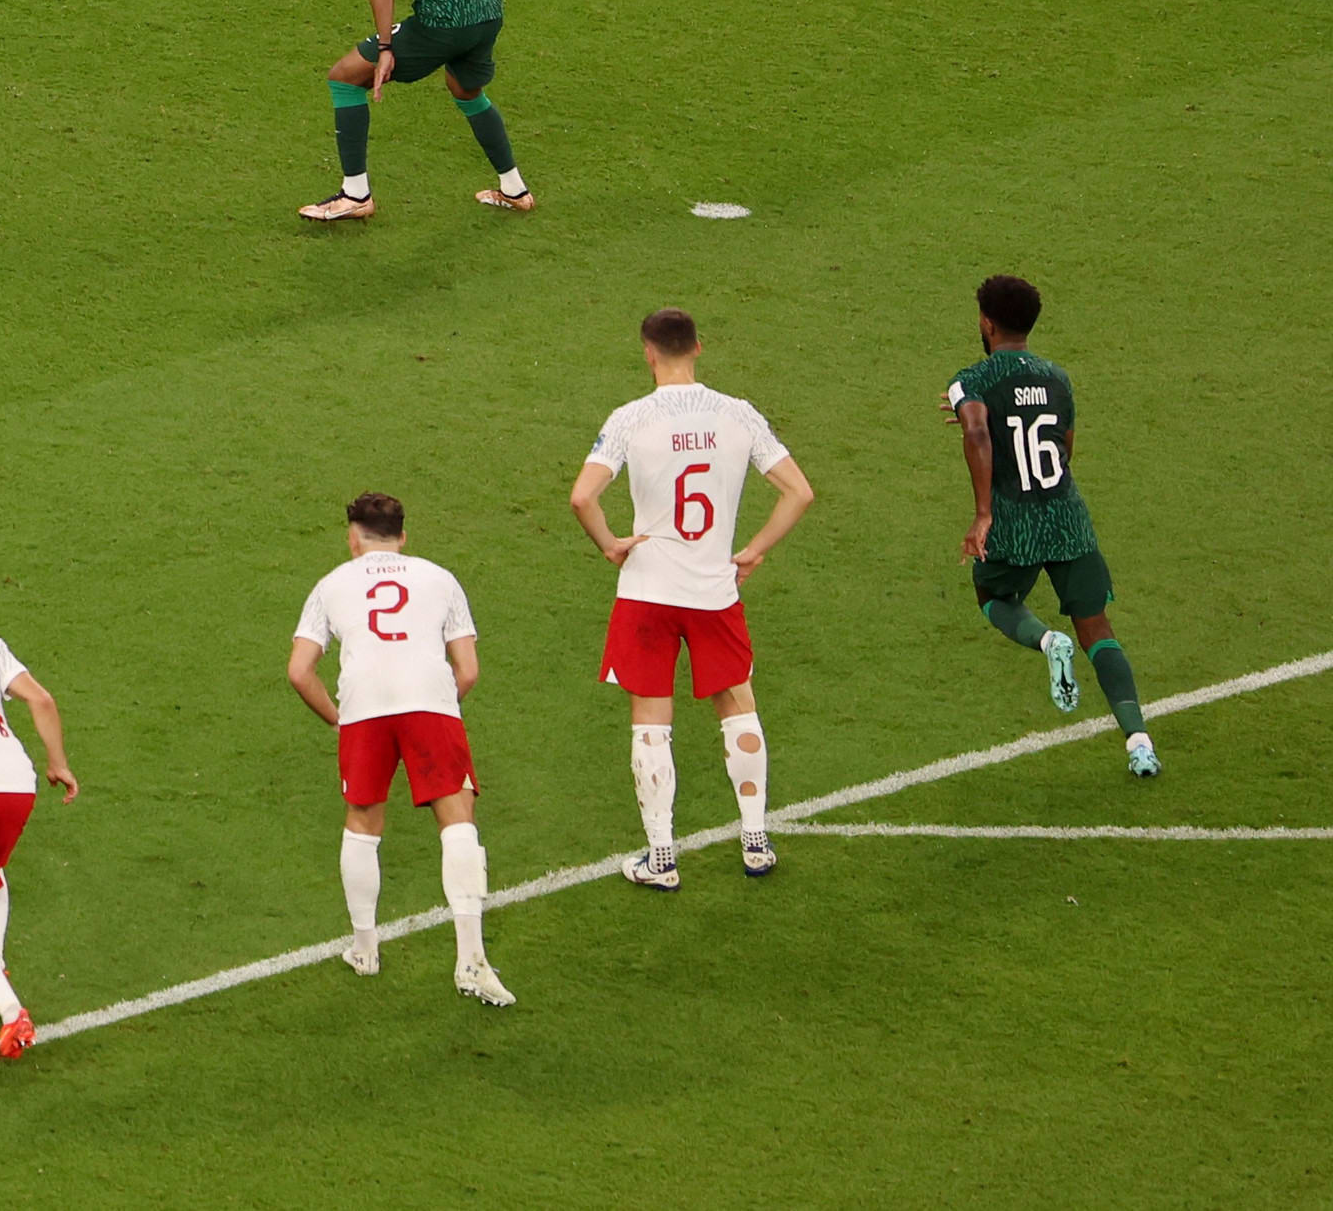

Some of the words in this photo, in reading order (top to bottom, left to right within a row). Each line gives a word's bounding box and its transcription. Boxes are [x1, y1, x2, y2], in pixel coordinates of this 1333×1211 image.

[1014, 386, 1048, 407] SAMI
[672, 431, 717, 452] BIELIK
[1006, 413, 1064, 492] 16
[673, 463, 715, 541] 6
[365, 580, 409, 641] 2
